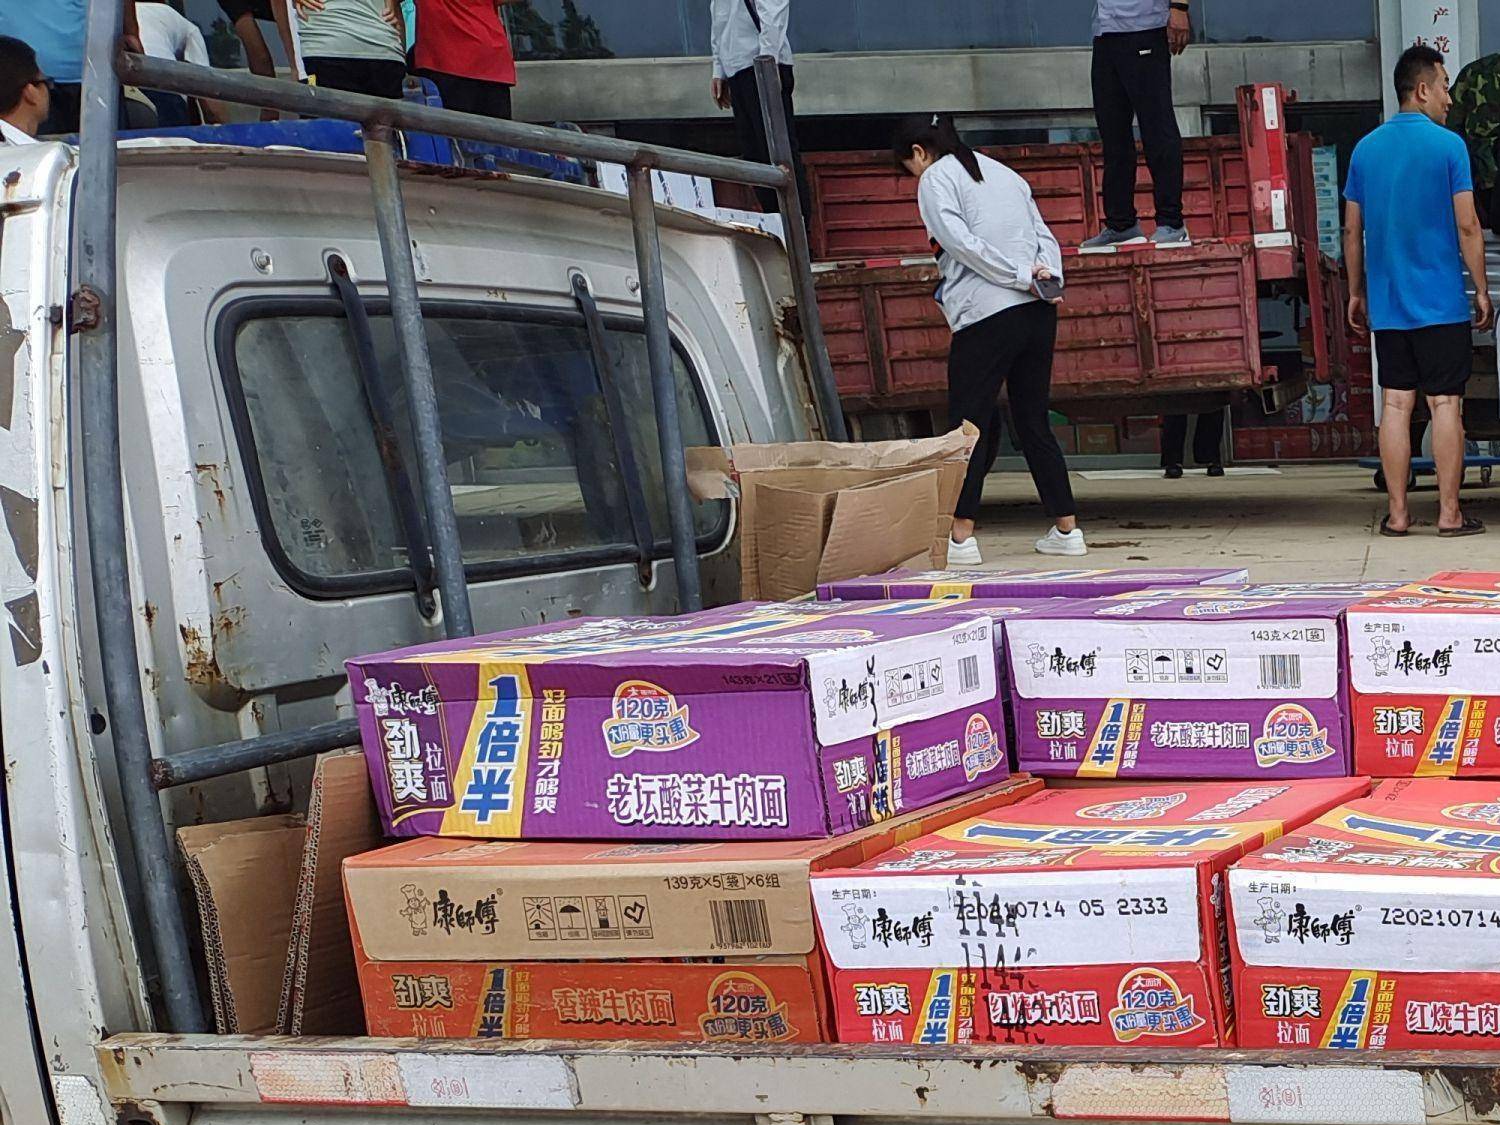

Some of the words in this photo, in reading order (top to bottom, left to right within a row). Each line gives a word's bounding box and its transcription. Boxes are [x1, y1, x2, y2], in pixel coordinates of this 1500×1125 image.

[616, 699, 670, 719] 120克
[1037, 709, 1087, 739] 劲爽
[1373, 706, 1425, 735] 劲爽
[1091, 701, 1125, 767] 1倍半
[1151, 721, 1250, 749] 老坛酸菜牛肉面
[1268, 722, 1313, 738] 120克
[1428, 699, 1465, 765] 1倍半
[383, 719, 427, 801] 劲爽
[459, 674, 524, 825] 1倍半
[534, 689, 566, 814] 好面够劲才够爽
[1050, 741, 1077, 761] 拉面
[1385, 738, 1414, 758] 拉面
[424, 743, 448, 801] 拉面
[833, 756, 867, 791] 劲爽
[607, 774, 788, 826] 老坛酸菜牛肉面
[433, 889, 500, 935] 康師傅
[1080, 899, 1105, 916] 05
[1118, 897, 1168, 916] 2333
[872, 908, 934, 948] 康師傅
[1287, 903, 1354, 946] 康師傅
[392, 974, 453, 1010] 劲爽
[552, 988, 676, 1025] 香辣牛肉面
[712, 994, 768, 1014] 120克
[855, 983, 911, 1016] 劲爽
[920, 974, 951, 1044] 1倍半
[1121, 990, 1176, 1007] 120克
[1261, 985, 1323, 1018] 劲爽
[872, 1019, 904, 1042] 拉面
[1277, 1020, 1311, 1045] 拉面
